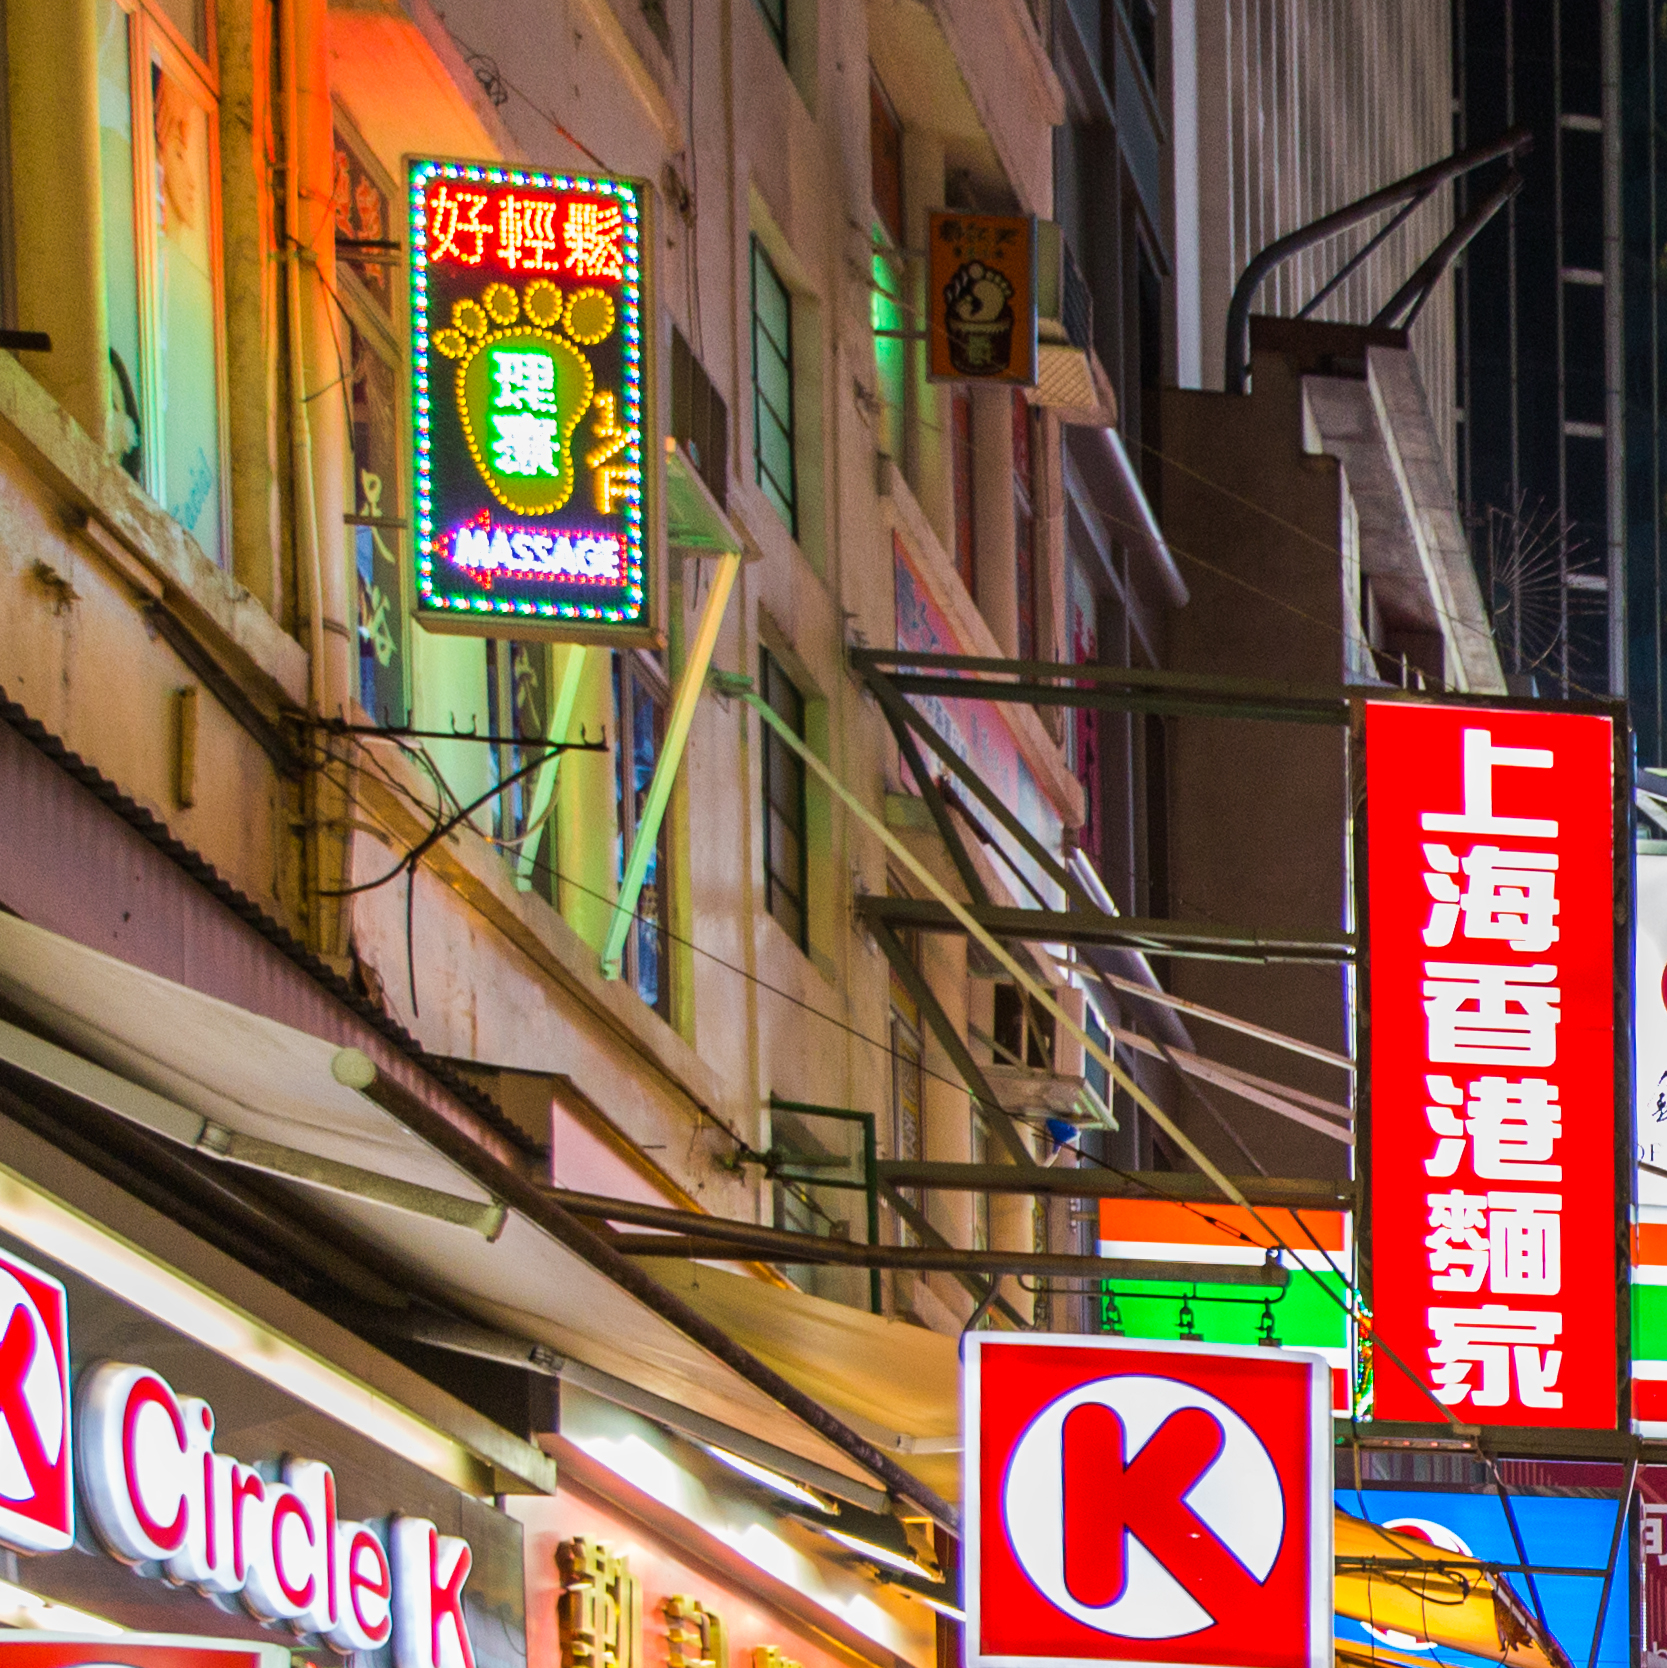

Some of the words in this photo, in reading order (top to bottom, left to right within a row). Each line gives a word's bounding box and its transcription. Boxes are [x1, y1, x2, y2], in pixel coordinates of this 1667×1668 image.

[430, 191, 624, 280] 好輕鬆
[454, 527, 620, 577] MASSAGE
[1421, 727, 1563, 1409] 上海香港麵家
[122, 1373, 391, 1642] Circle
